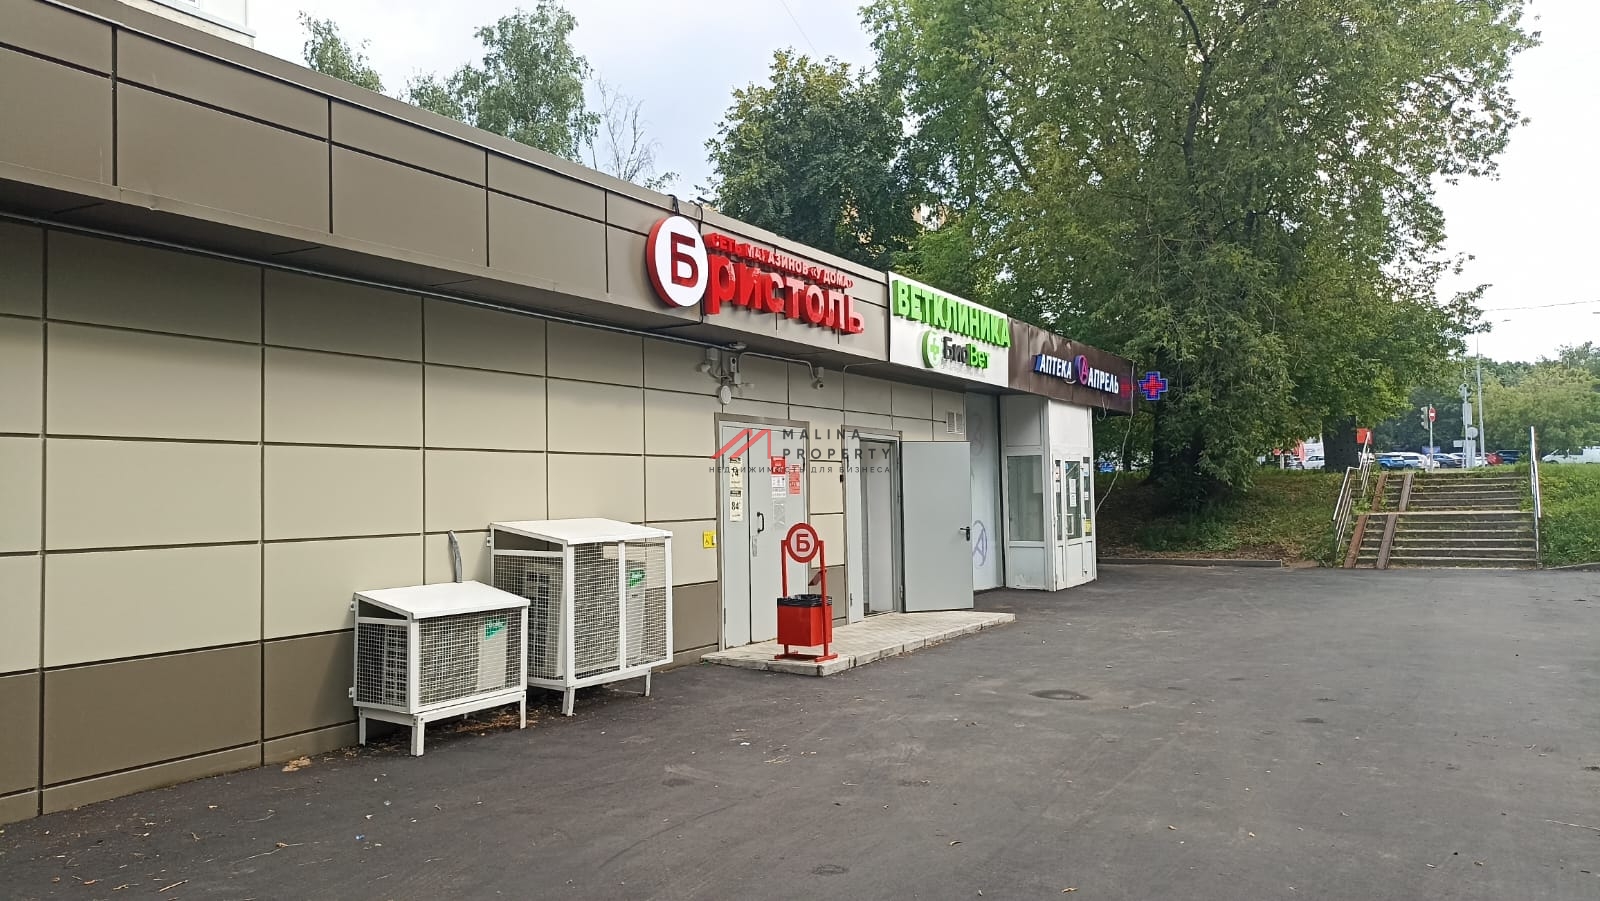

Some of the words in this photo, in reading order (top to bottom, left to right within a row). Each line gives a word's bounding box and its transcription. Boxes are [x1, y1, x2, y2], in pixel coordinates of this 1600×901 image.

[704, 232, 744, 258] СЕТЬ
[742, 243, 809, 275] МАГАЗИНОВ
[892, 279, 1011, 348] ВЕТКЛИНИКА
[1034, 354, 1073, 380] АПТЕКА
[1087, 367, 1120, 394] АПРЕЛЬ
[796, 533, 811, 553] Б
